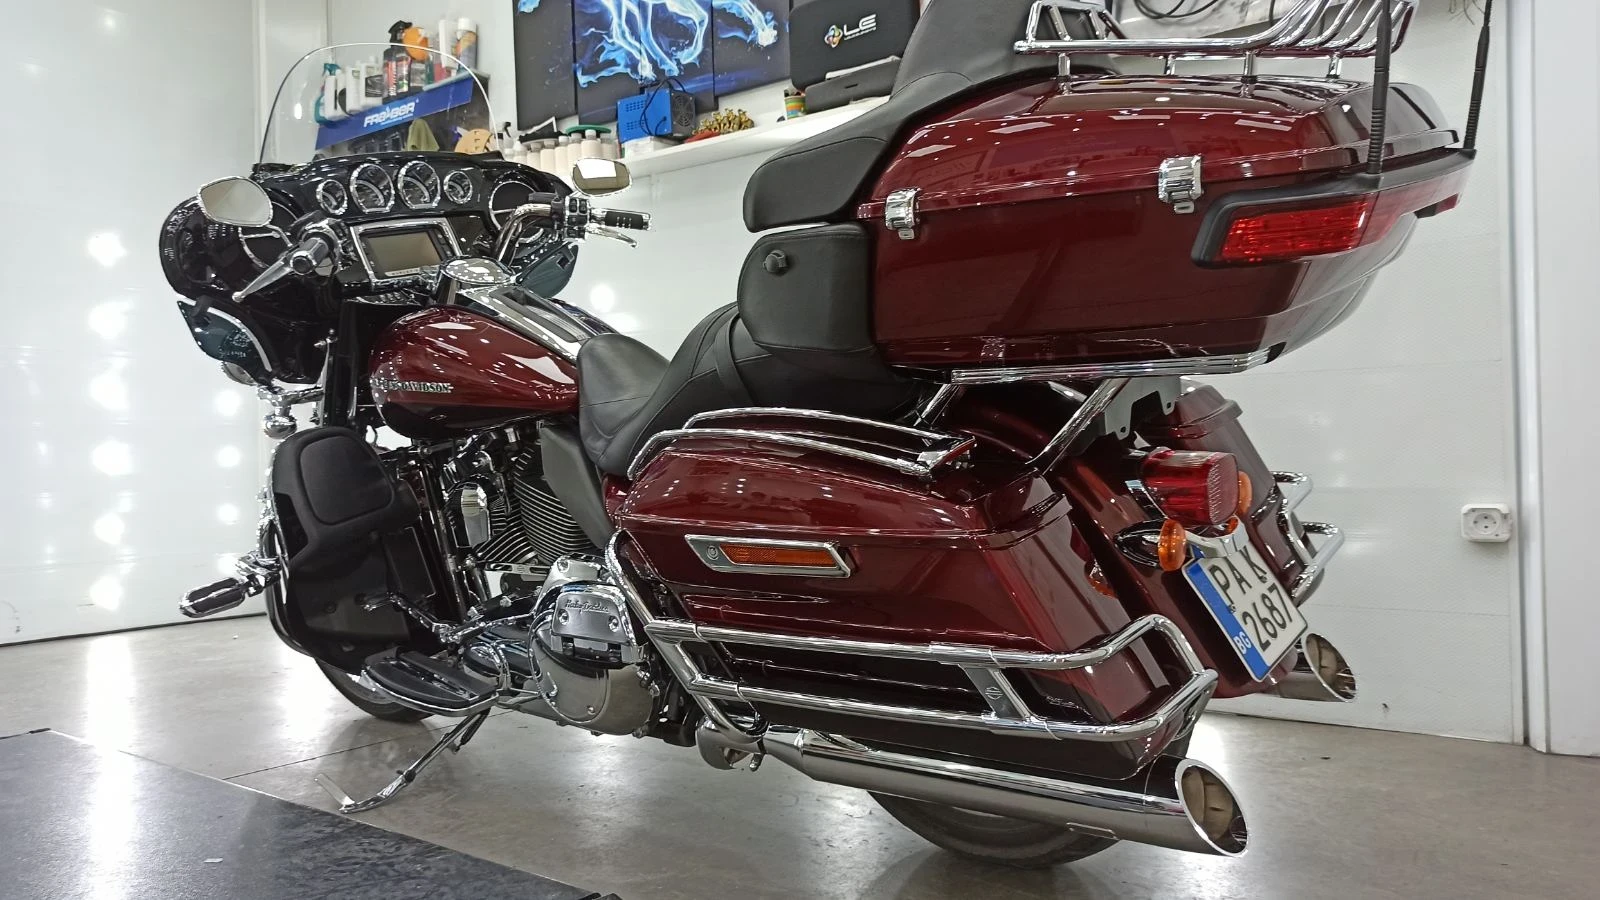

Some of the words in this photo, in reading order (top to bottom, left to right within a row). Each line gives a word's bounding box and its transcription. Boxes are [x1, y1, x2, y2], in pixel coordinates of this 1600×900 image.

[843, 14, 877, 36] LE
[1241, 582, 1293, 652] 2687
[1232, 631, 1252, 655] BG
